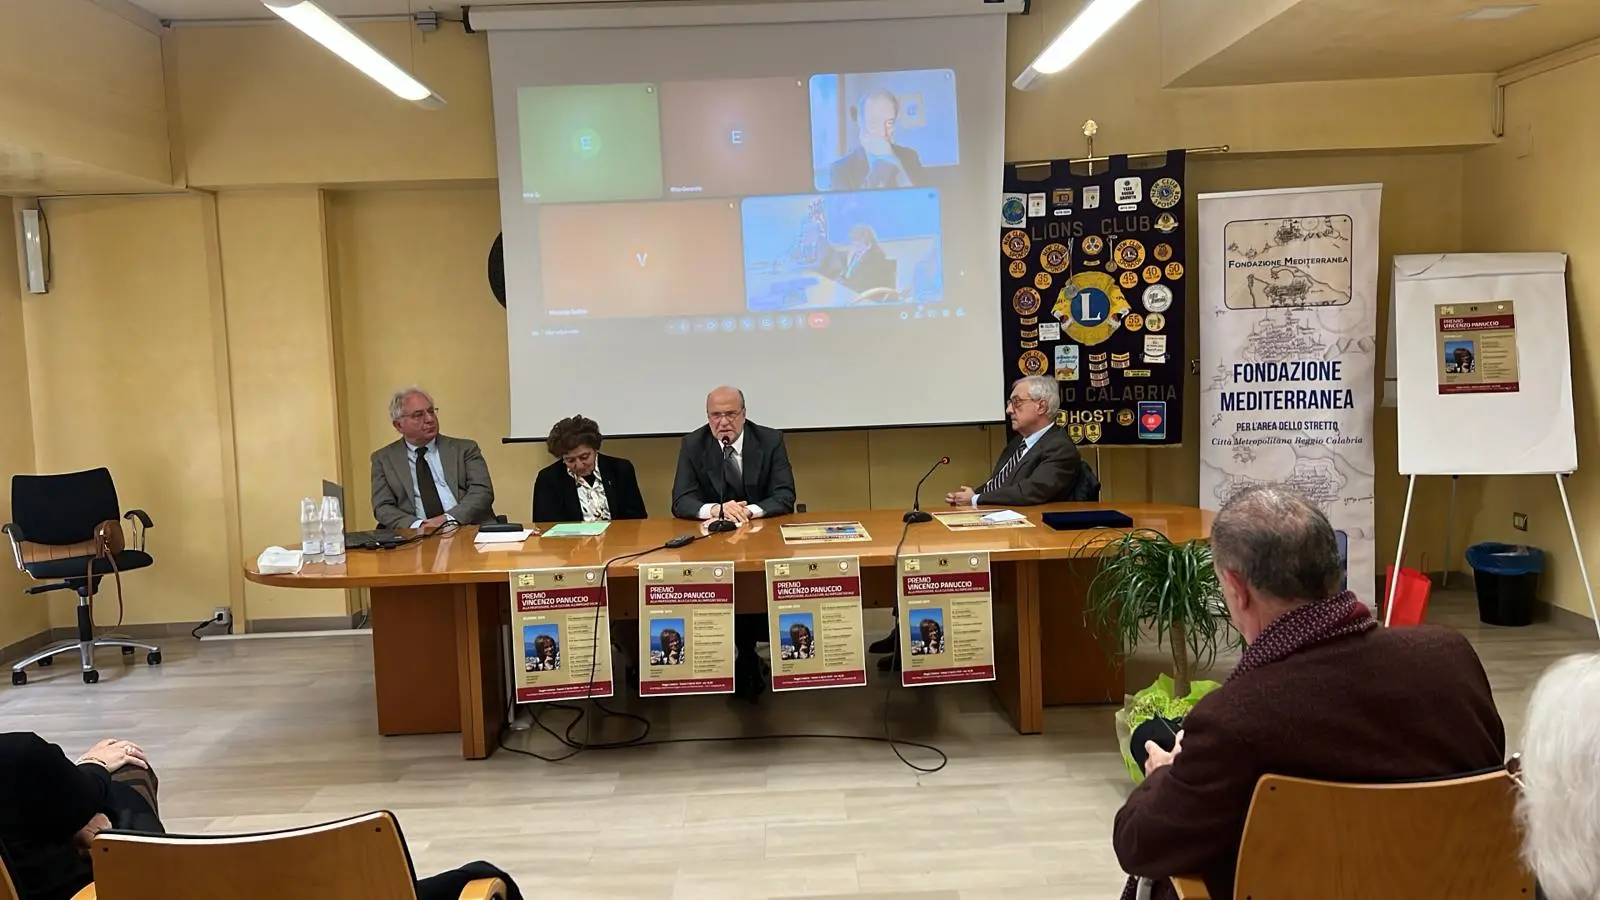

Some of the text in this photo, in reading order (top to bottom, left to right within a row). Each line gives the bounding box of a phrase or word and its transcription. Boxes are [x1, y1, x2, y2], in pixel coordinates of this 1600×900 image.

[581, 136, 592, 150] E
[732, 130, 742, 144] E
[1162, 178, 1178, 188] CLUB
[1032, 216, 1150, 241] LIONS CLUB
[636, 253, 647, 267] V
[1013, 262, 1023, 271] 30
[1228, 257, 1348, 268] FONDAZIONE MEDITERRANEA
[1146, 267, 1157, 276] 40
[1169, 264, 1180, 272] 50
[1038, 274, 1048, 282] 35
[1080, 293, 1101, 320] L
[1234, 361, 1342, 383] FONDAZIONE
[1086, 385, 1177, 402] CALABRIA
[1220, 389, 1354, 411] MEDITERRANEA
[1070, 409, 1114, 423] HOST
[1236, 421, 1338, 431] PER L'AREA DELLO STRETTO
[1234, 437, 1292, 446] Metropolitana
[1295, 436, 1323, 446] Reggio
[1326, 436, 1363, 444] Calabria
